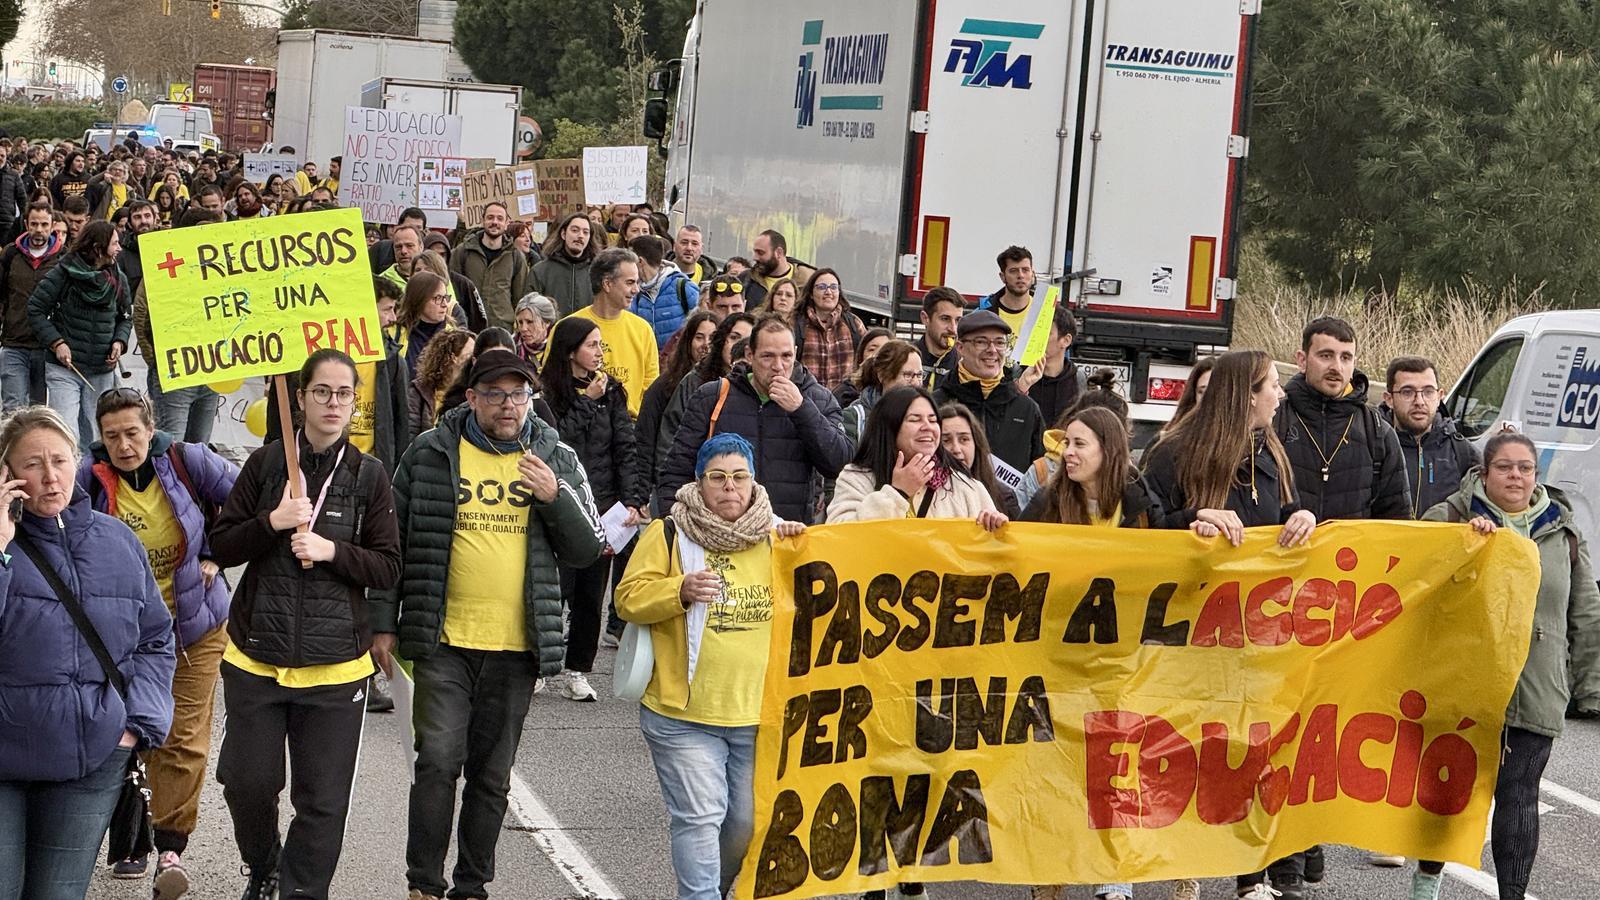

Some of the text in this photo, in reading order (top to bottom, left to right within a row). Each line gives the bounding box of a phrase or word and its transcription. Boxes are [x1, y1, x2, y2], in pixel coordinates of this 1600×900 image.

[821, 33, 889, 86] TRANSAGUIMU
[1105, 44, 1235, 71] TRANSAGUIMU
[1122, 70, 1133, 78] 950
[1173, 75, 1190, 83] EJIDO
[1194, 77, 1221, 85] ALMERIA
[351, 109, 447, 136] L'EDUCACIÓ
[345, 134, 369, 159] NO
[374, 133, 399, 161] ÉS
[587, 149, 641, 164] SISTEMA
[351, 159, 369, 184] ÉS
[197, 227, 357, 280] RECURSOS
[202, 282, 331, 321] PER UNA
[166, 317, 380, 380] EDUCACIÓ REAL
[995, 465, 1021, 487] INVER
[458, 477, 534, 508] SOS
[480, 523, 491, 532] DE
[788, 559, 1048, 677] PASSEM
[1062, 577, 1120, 645] A
[777, 675, 1055, 781] PER UNA
[752, 688, 1479, 900] BONA EDUCACIÓ
